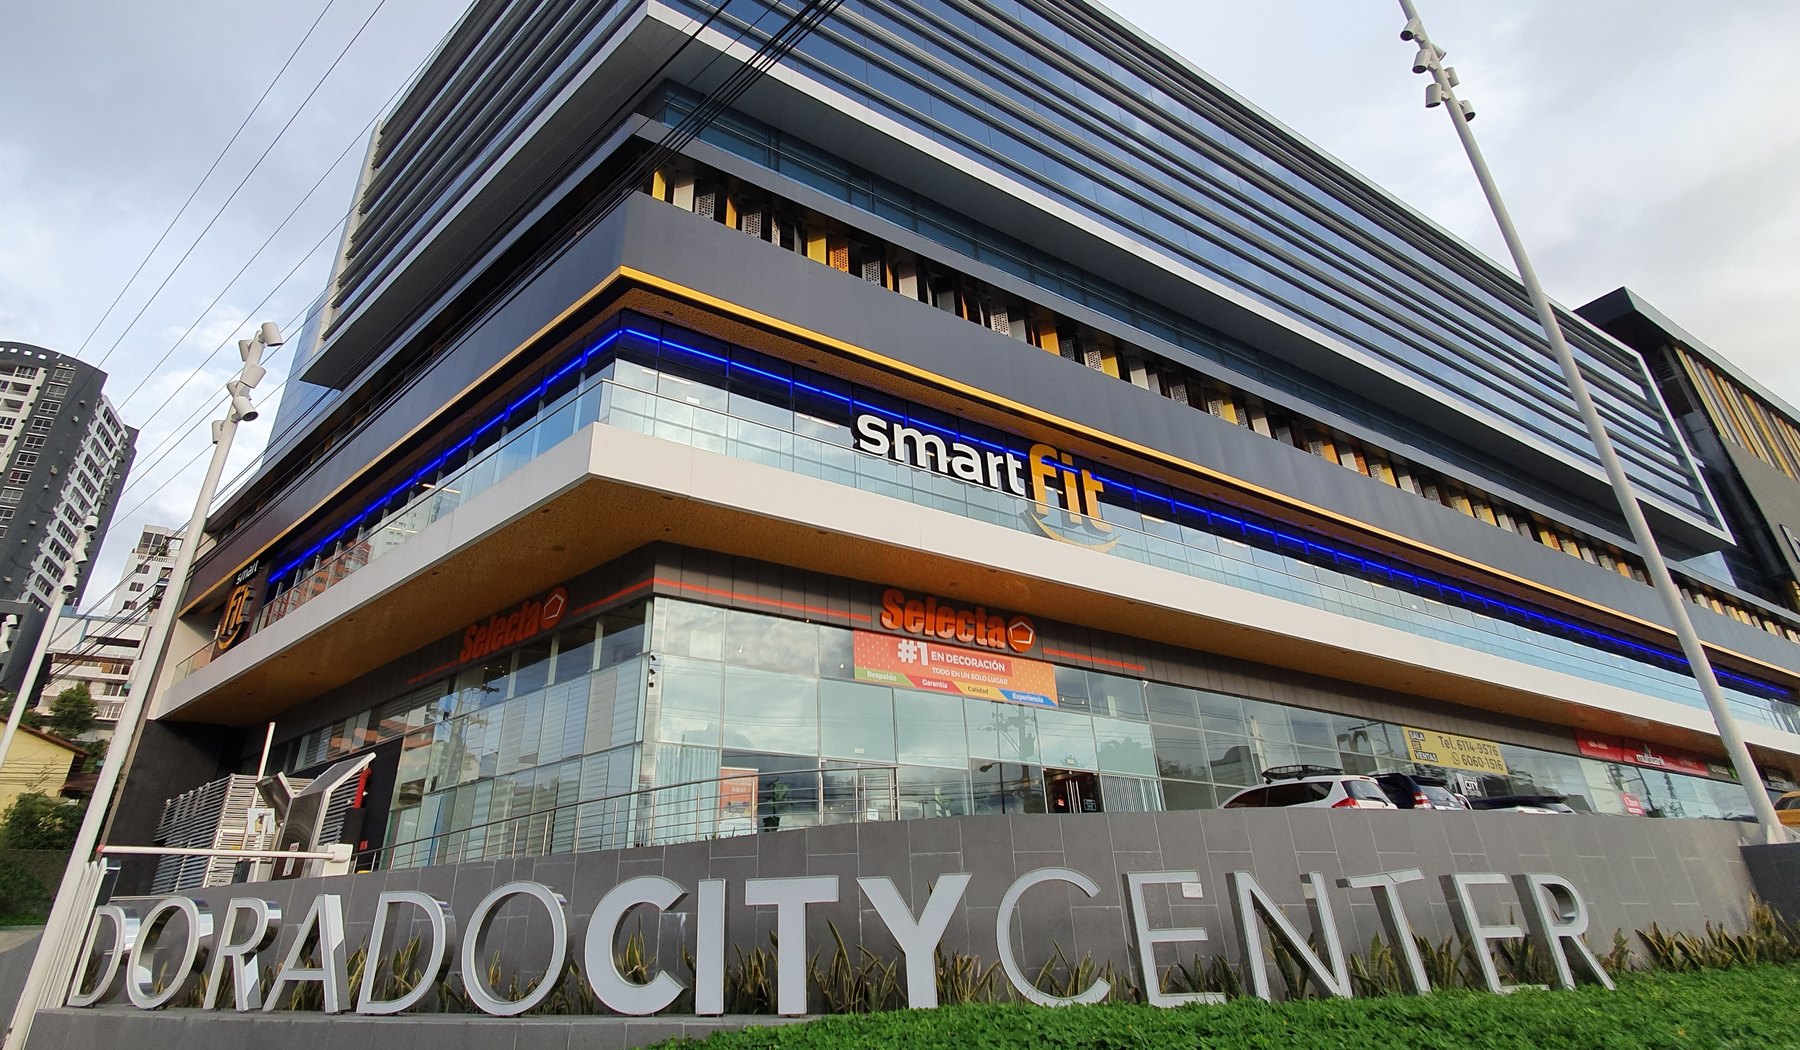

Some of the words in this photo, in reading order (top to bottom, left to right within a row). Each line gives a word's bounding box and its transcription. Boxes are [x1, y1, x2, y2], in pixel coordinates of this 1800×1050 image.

[856, 414, 1026, 497] smart
[1029, 443, 1113, 534] fit
[235, 560, 260, 585] smart
[881, 588, 1006, 649] Selecta
[460, 601, 542, 664] Selecta
[897, 639, 929, 667] #1
[931, 651, 945, 662] EN
[946, 654, 1006, 672] DECORACIÓN
[867, 670, 897, 682] Respaldo
[931, 666, 949, 676] TODO
[950, 669, 960, 678] EN
[960, 670, 970, 680] UN
[970, 672, 987, 682] SOLO
[987, 674, 1008, 686] LUGAR
[1415, 751, 1437, 762] VENTAS
[1438, 735, 1456, 750] Tel.
[1457, 739, 1499, 757] 6114-9576
